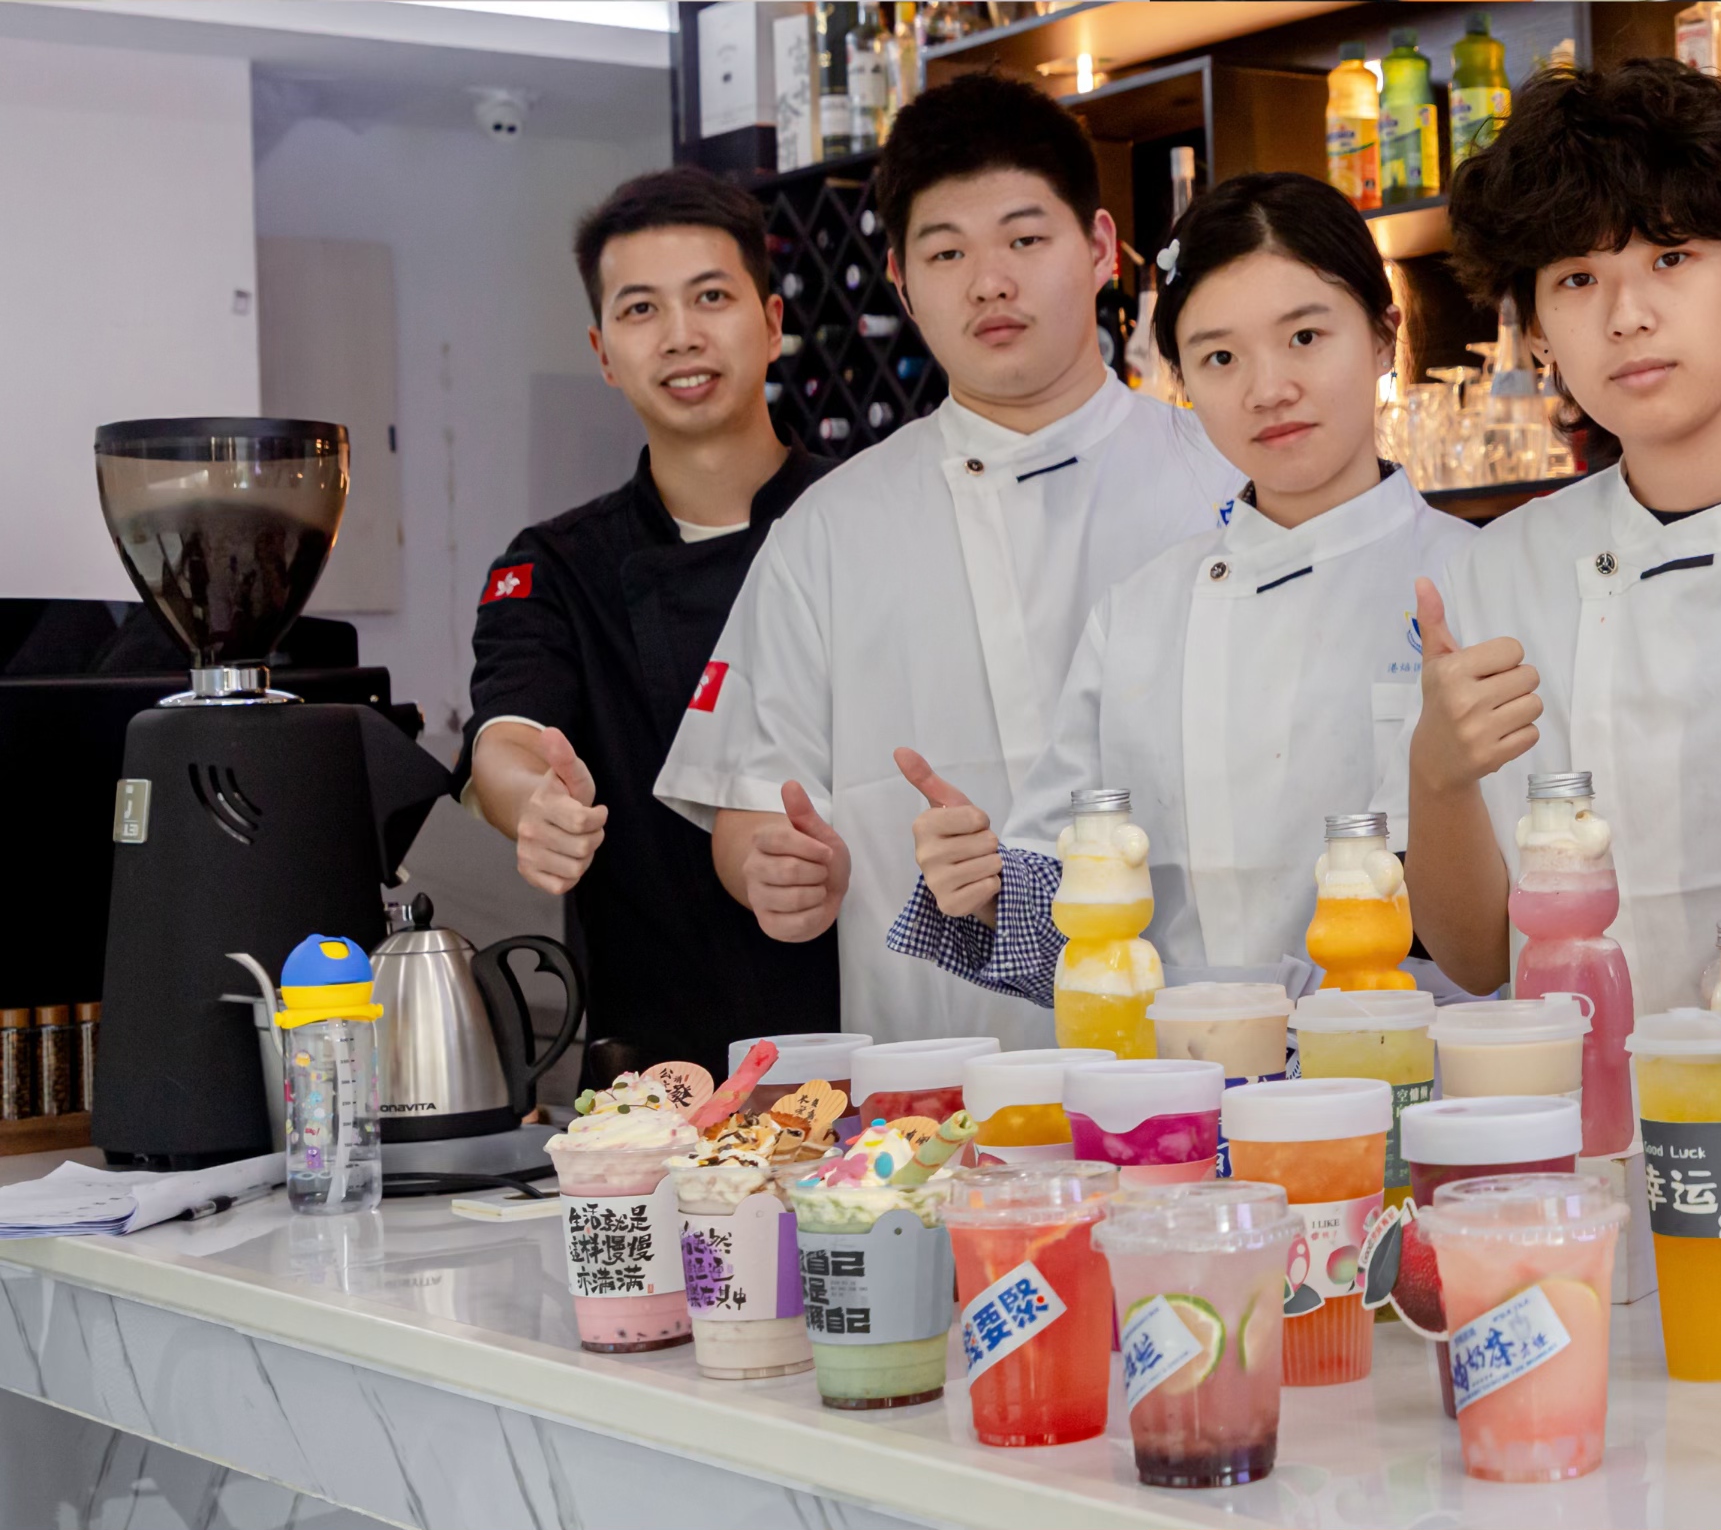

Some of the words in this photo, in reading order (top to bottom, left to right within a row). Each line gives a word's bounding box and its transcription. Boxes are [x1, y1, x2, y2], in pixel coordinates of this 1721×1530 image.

[1669, 1145, 1707, 1160] Luck
[1645, 1162, 1718, 1215] 幸运
[1318, 1217, 1340, 1228] LIKE
